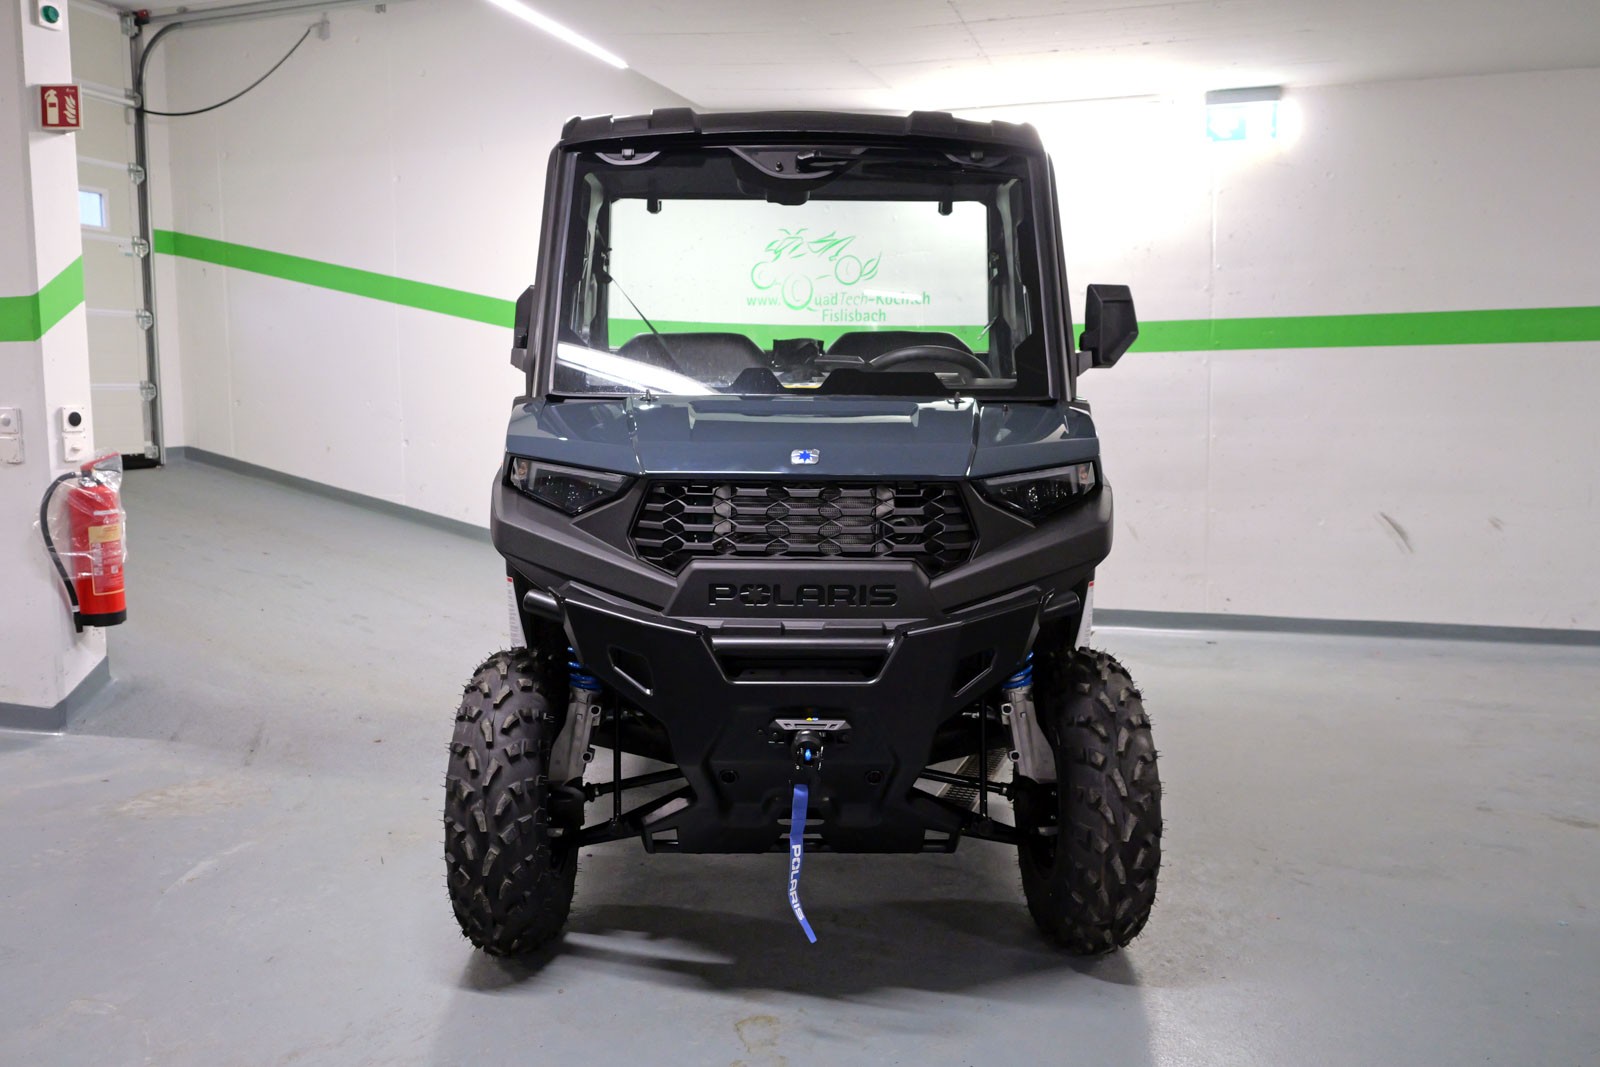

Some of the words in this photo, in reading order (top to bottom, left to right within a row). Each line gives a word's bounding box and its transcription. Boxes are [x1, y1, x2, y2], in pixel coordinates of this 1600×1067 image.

[821, 308, 887, 322] Fislisbach
[708, 583, 898, 607] POLARIS
[788, 844, 804, 921] POLARIS
